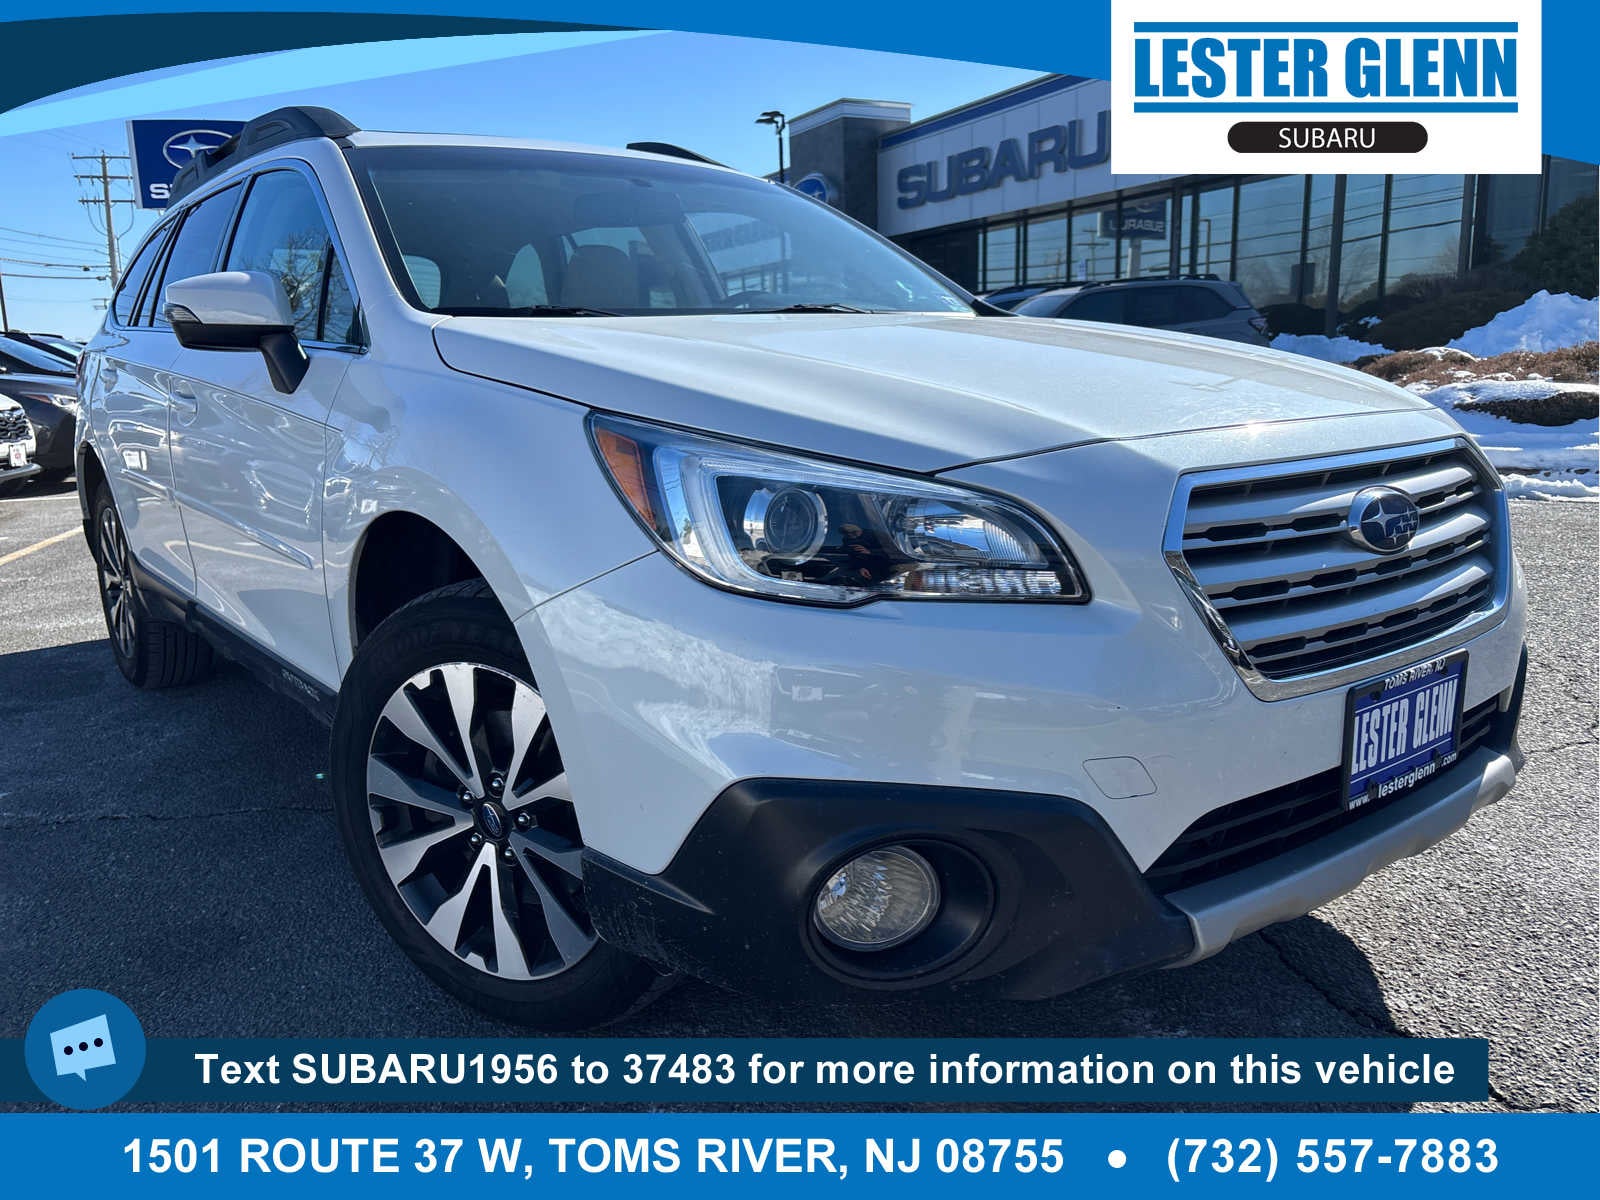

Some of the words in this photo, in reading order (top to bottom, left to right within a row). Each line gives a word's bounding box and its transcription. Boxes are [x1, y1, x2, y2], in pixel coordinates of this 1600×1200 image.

[896, 109, 1111, 210] SUBARU
[1351, 697, 1409, 775] LESTER
[1412, 678, 1459, 749] GLENN
[1384, 670, 1408, 690] TOMS
